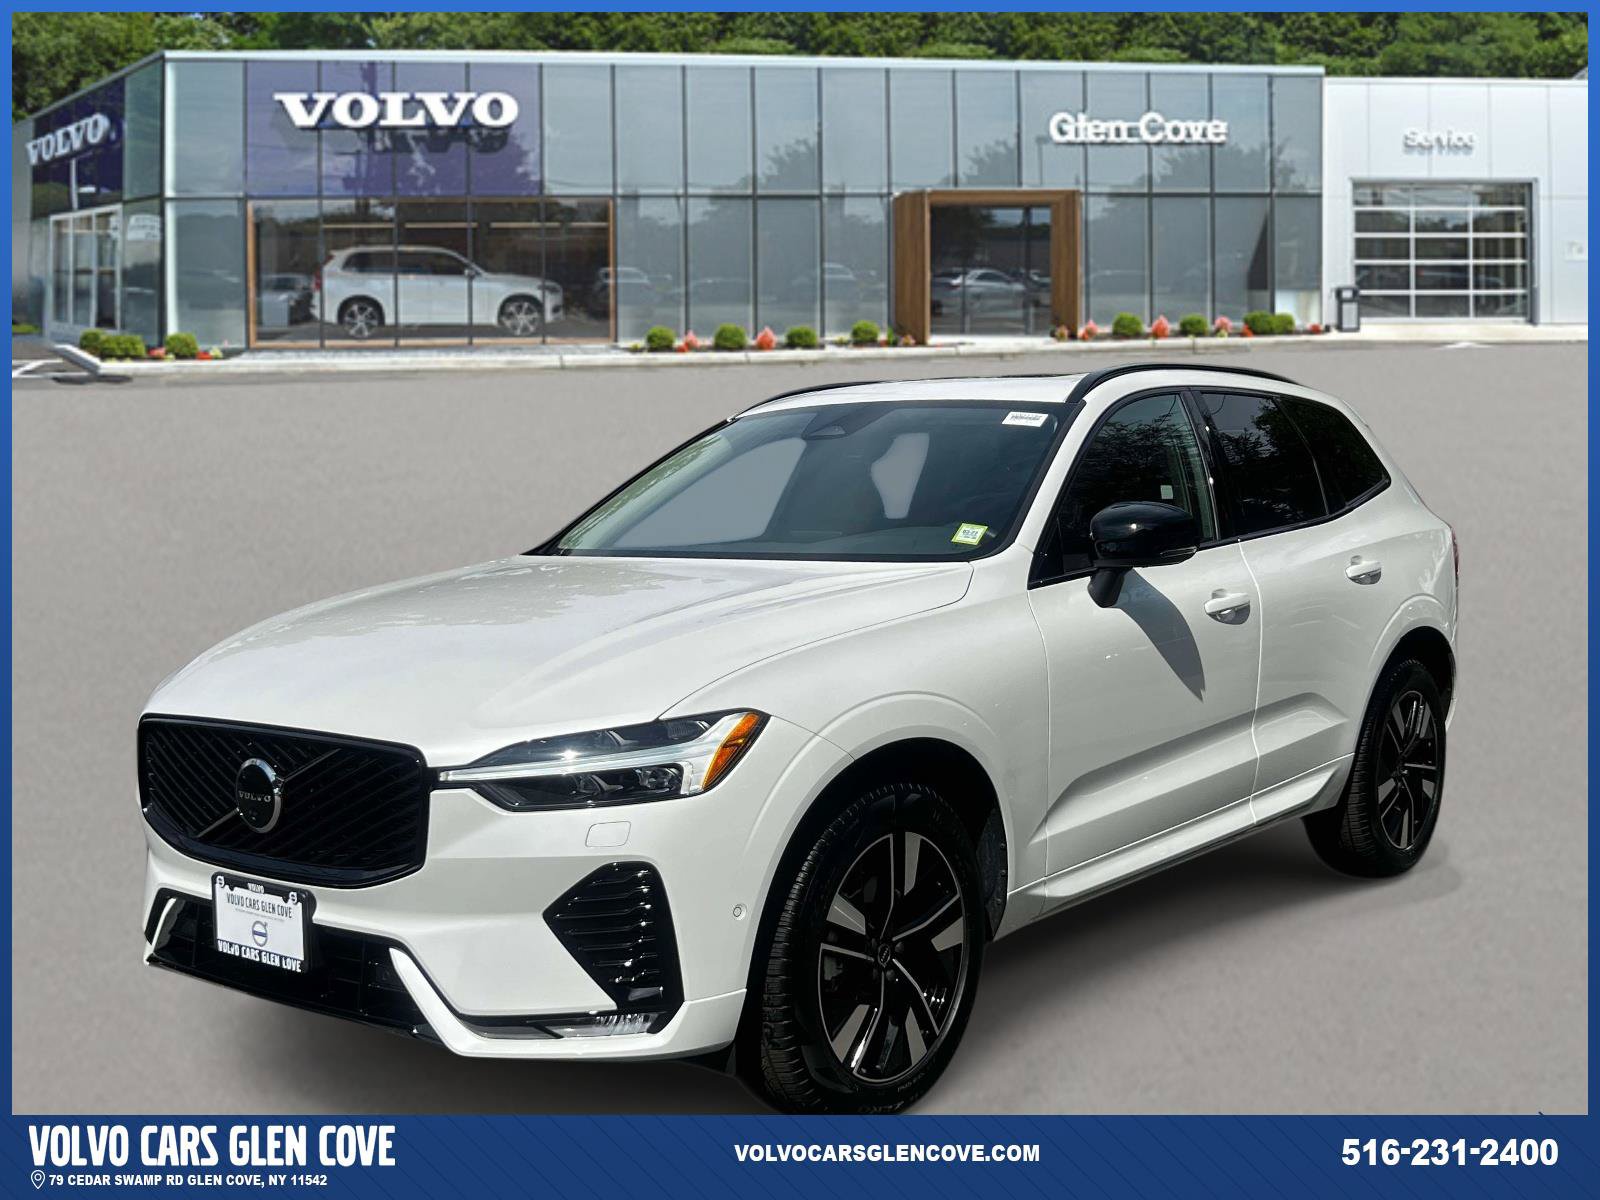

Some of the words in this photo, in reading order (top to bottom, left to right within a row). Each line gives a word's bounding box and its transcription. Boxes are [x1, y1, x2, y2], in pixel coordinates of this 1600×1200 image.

[273, 92, 519, 128] VOLVO
[25, 113, 110, 165] VOLVO
[1050, 111, 1130, 143] Glen
[1140, 111, 1228, 143] Cove
[1403, 127, 1477, 151] Service
[238, 790, 272, 803] VOLVO
[226, 893, 245, 909] VOLVO
[245, 897, 260, 911] CARS
[261, 901, 276, 914] GLEN
[277, 905, 293, 918] COVE
[241, 946, 260, 961] CARS
[261, 951, 280, 967] GLEN
